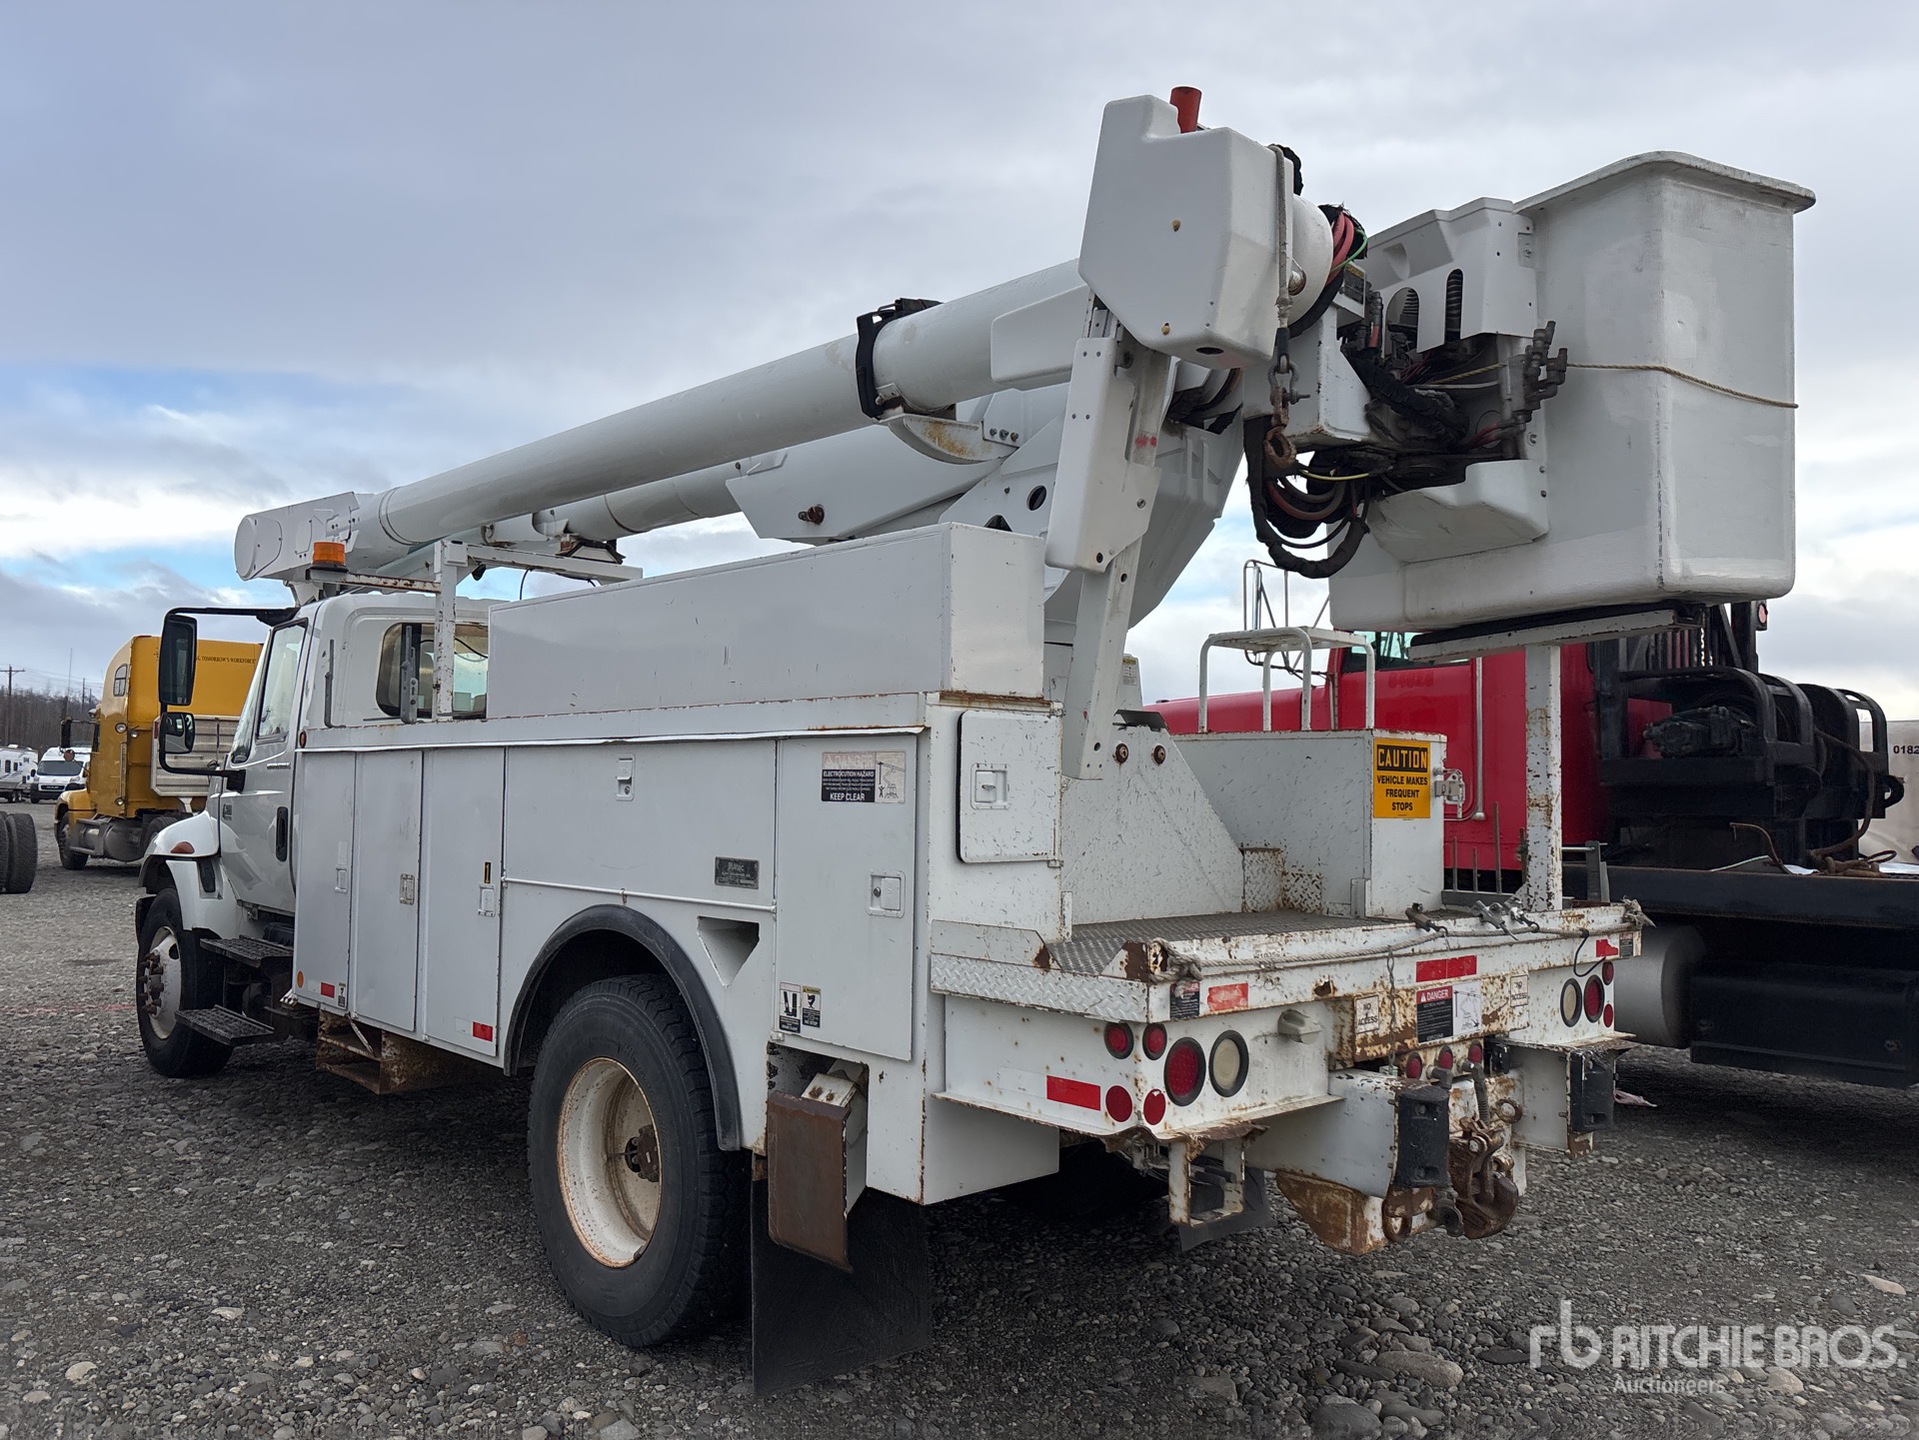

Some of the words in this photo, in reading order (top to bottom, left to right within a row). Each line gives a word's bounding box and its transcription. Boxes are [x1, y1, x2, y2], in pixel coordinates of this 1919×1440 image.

[1378, 748, 1427, 769] CAUTION
[1377, 775, 1404, 784] VEHICLE
[1406, 776, 1428, 785] MAKES
[830, 793, 844, 801] KEEP
[845, 793, 865, 801] CLEAR
[1386, 788, 1420, 798] FREQUENT
[1392, 801, 1413, 811] STOPS
[1426, 989, 1449, 1001] DANGER
